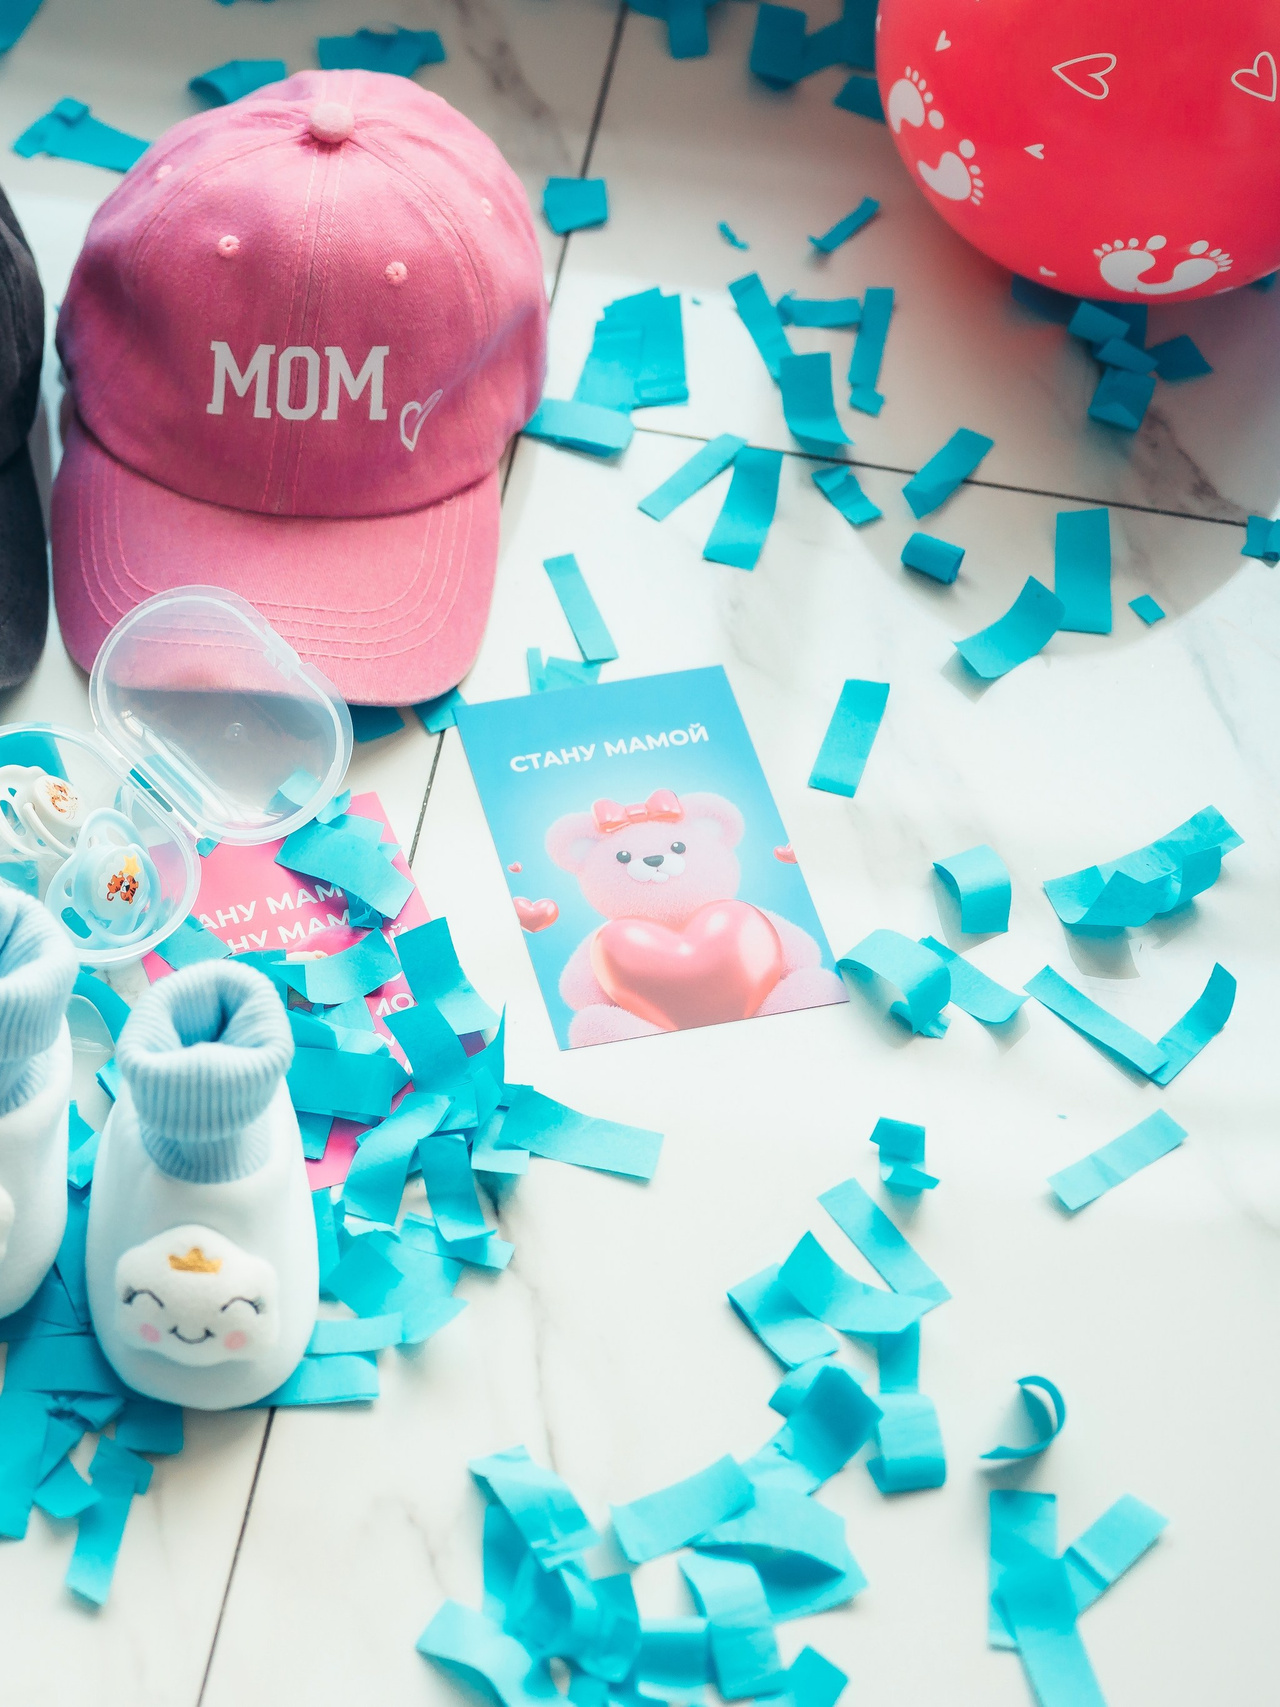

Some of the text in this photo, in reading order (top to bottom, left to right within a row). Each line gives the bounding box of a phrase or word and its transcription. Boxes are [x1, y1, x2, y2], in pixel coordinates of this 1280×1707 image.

[206, 340, 390, 421] MOM
[510, 722, 710, 773] СТАНУ МАМОЙ
[198, 884, 344, 930] АНУ МАМ
